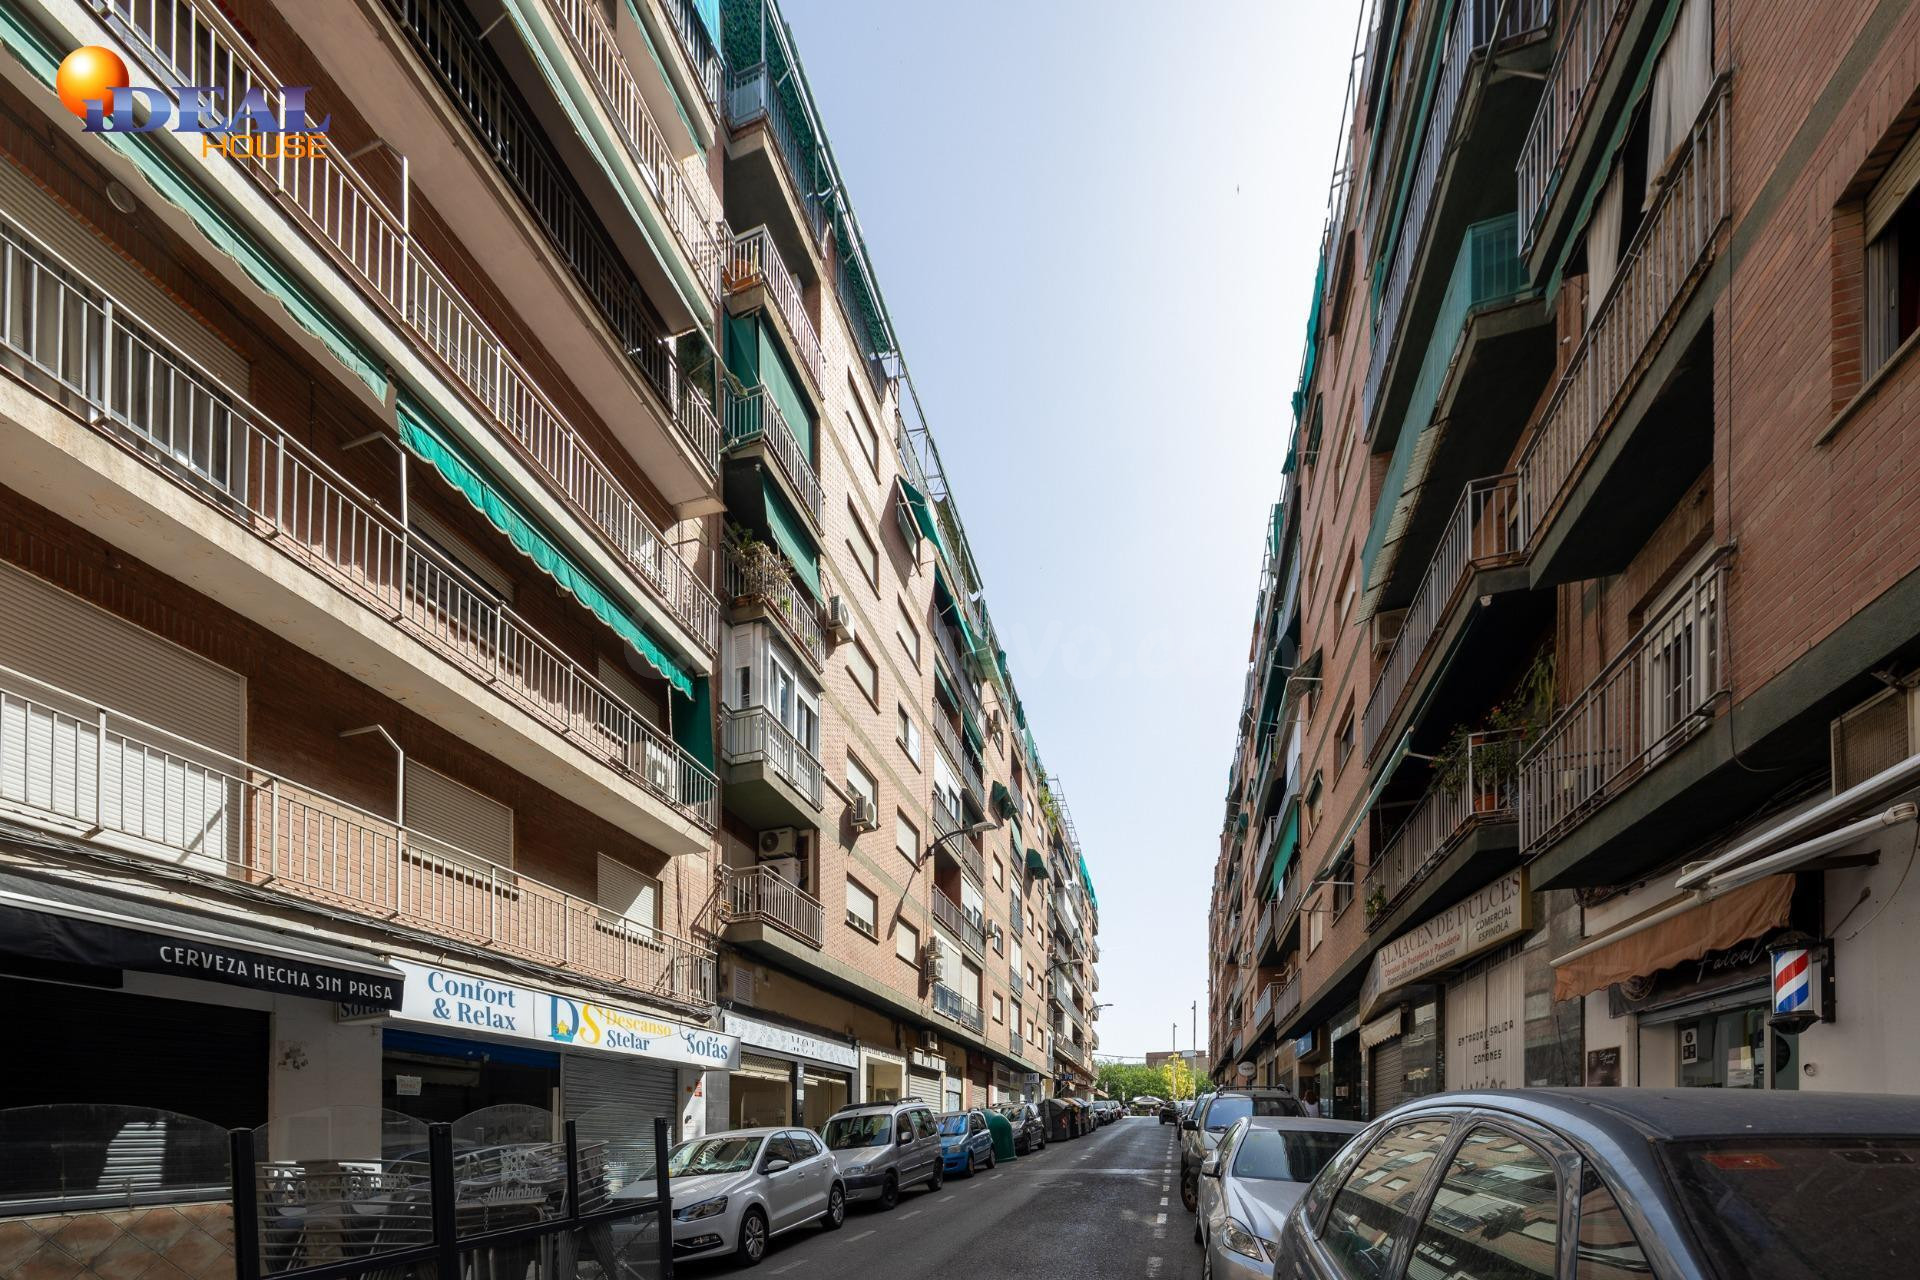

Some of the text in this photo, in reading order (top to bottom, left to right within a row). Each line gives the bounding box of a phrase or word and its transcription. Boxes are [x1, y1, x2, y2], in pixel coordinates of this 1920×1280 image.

[1437, 910, 1455, 937] DE
[1457, 871, 1520, 925] DULCES
[1475, 905, 1512, 931] COMERCIAL
[160, 946, 393, 1000] CERVEZA HECHA SIN PRISA
[427, 971, 516, 1008] Confort
[432, 997, 517, 1031] & Relax
[605, 1008, 672, 1037] Descanso
[606, 1029, 650, 1051] Stelar
[686, 1032, 728, 1060] Sofás
[482, 1183, 542, 1203] Alhambra
